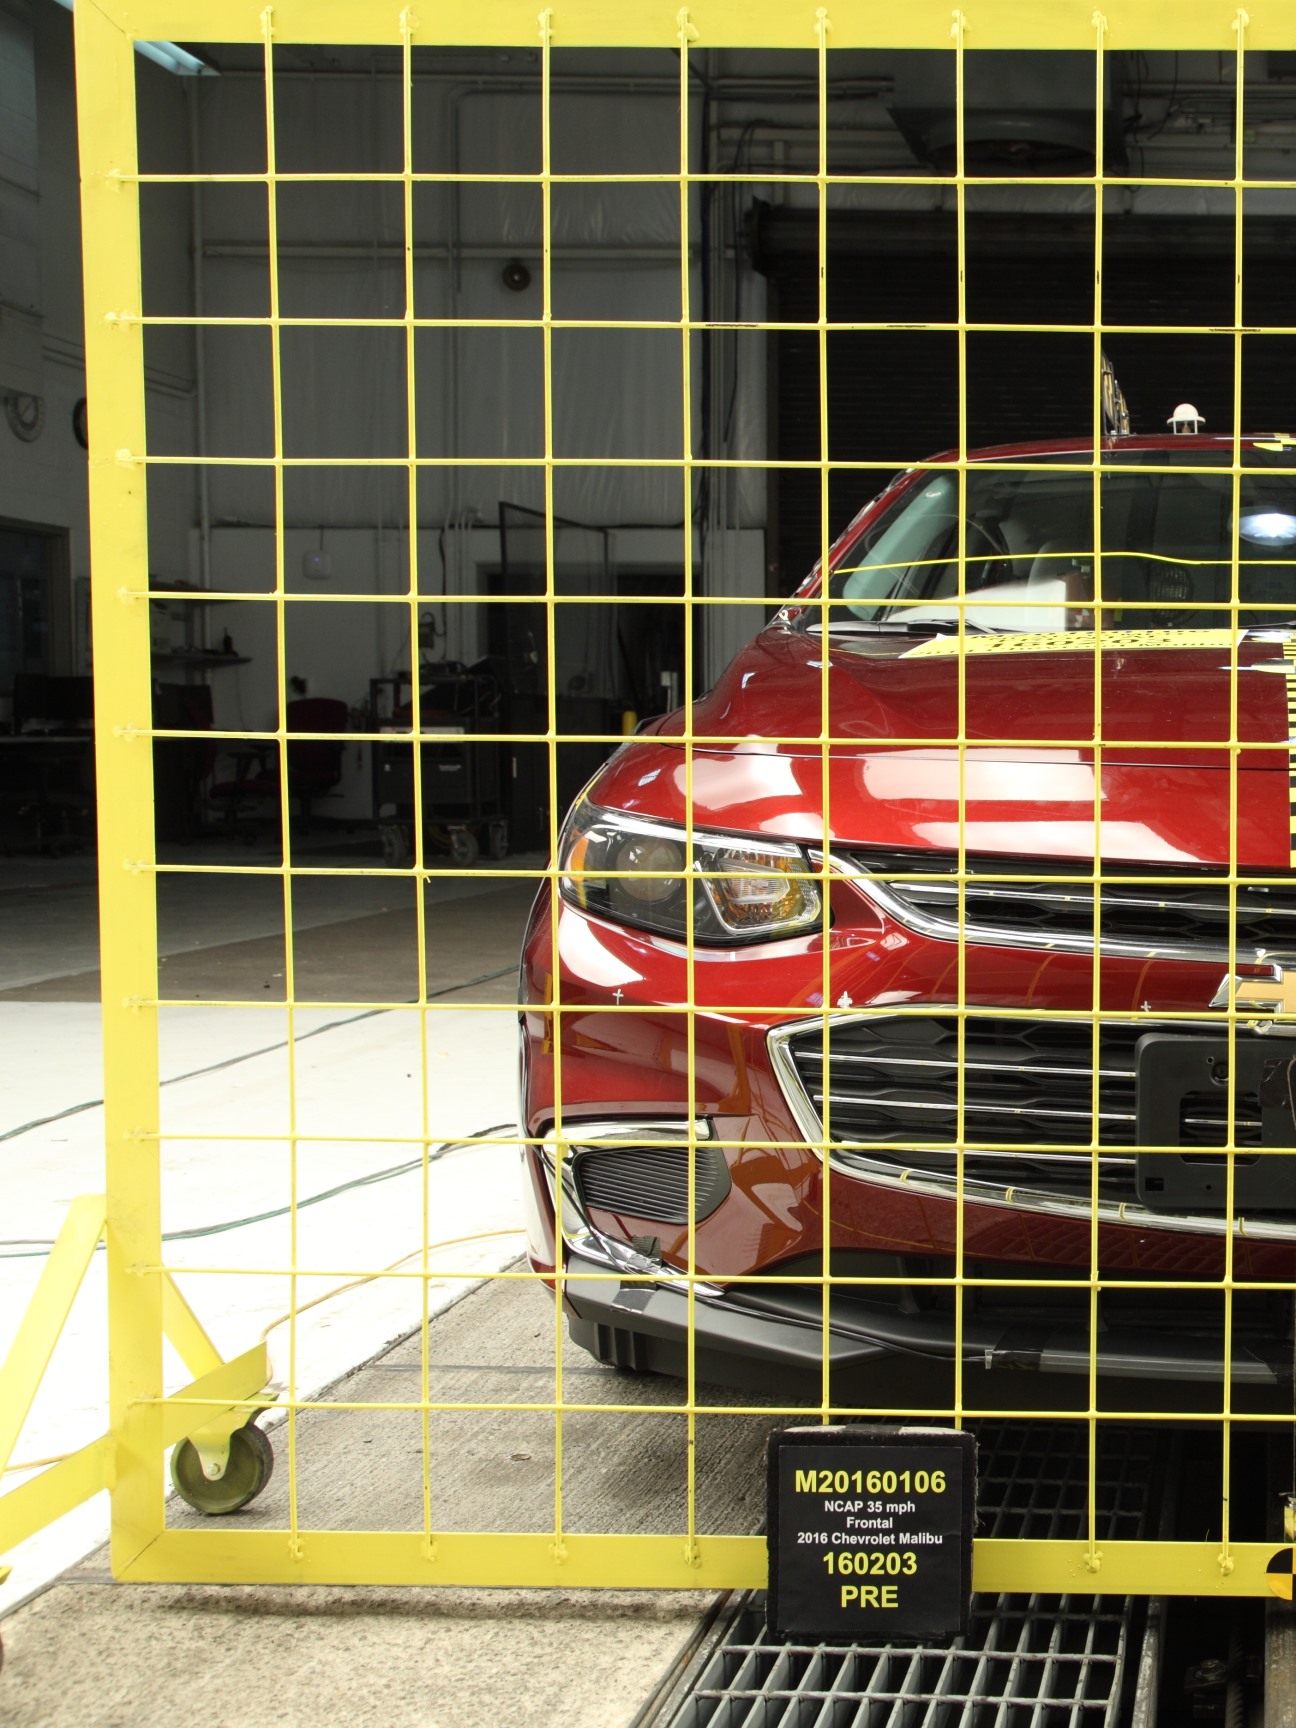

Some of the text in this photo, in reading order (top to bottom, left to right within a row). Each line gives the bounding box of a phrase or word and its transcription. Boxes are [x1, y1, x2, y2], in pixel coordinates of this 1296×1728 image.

[984, 638, 1172, 648] 160203
[795, 1470, 946, 1494] M20160106
[824, 1500, 916, 1515] NCAP 35 mph
[846, 1516, 893, 1529] Frontal
[797, 1532, 943, 1545] 2016 Chevrolet Malibu
[822, 1551, 918, 1576] 160203
[841, 1585, 899, 1608] PRE
